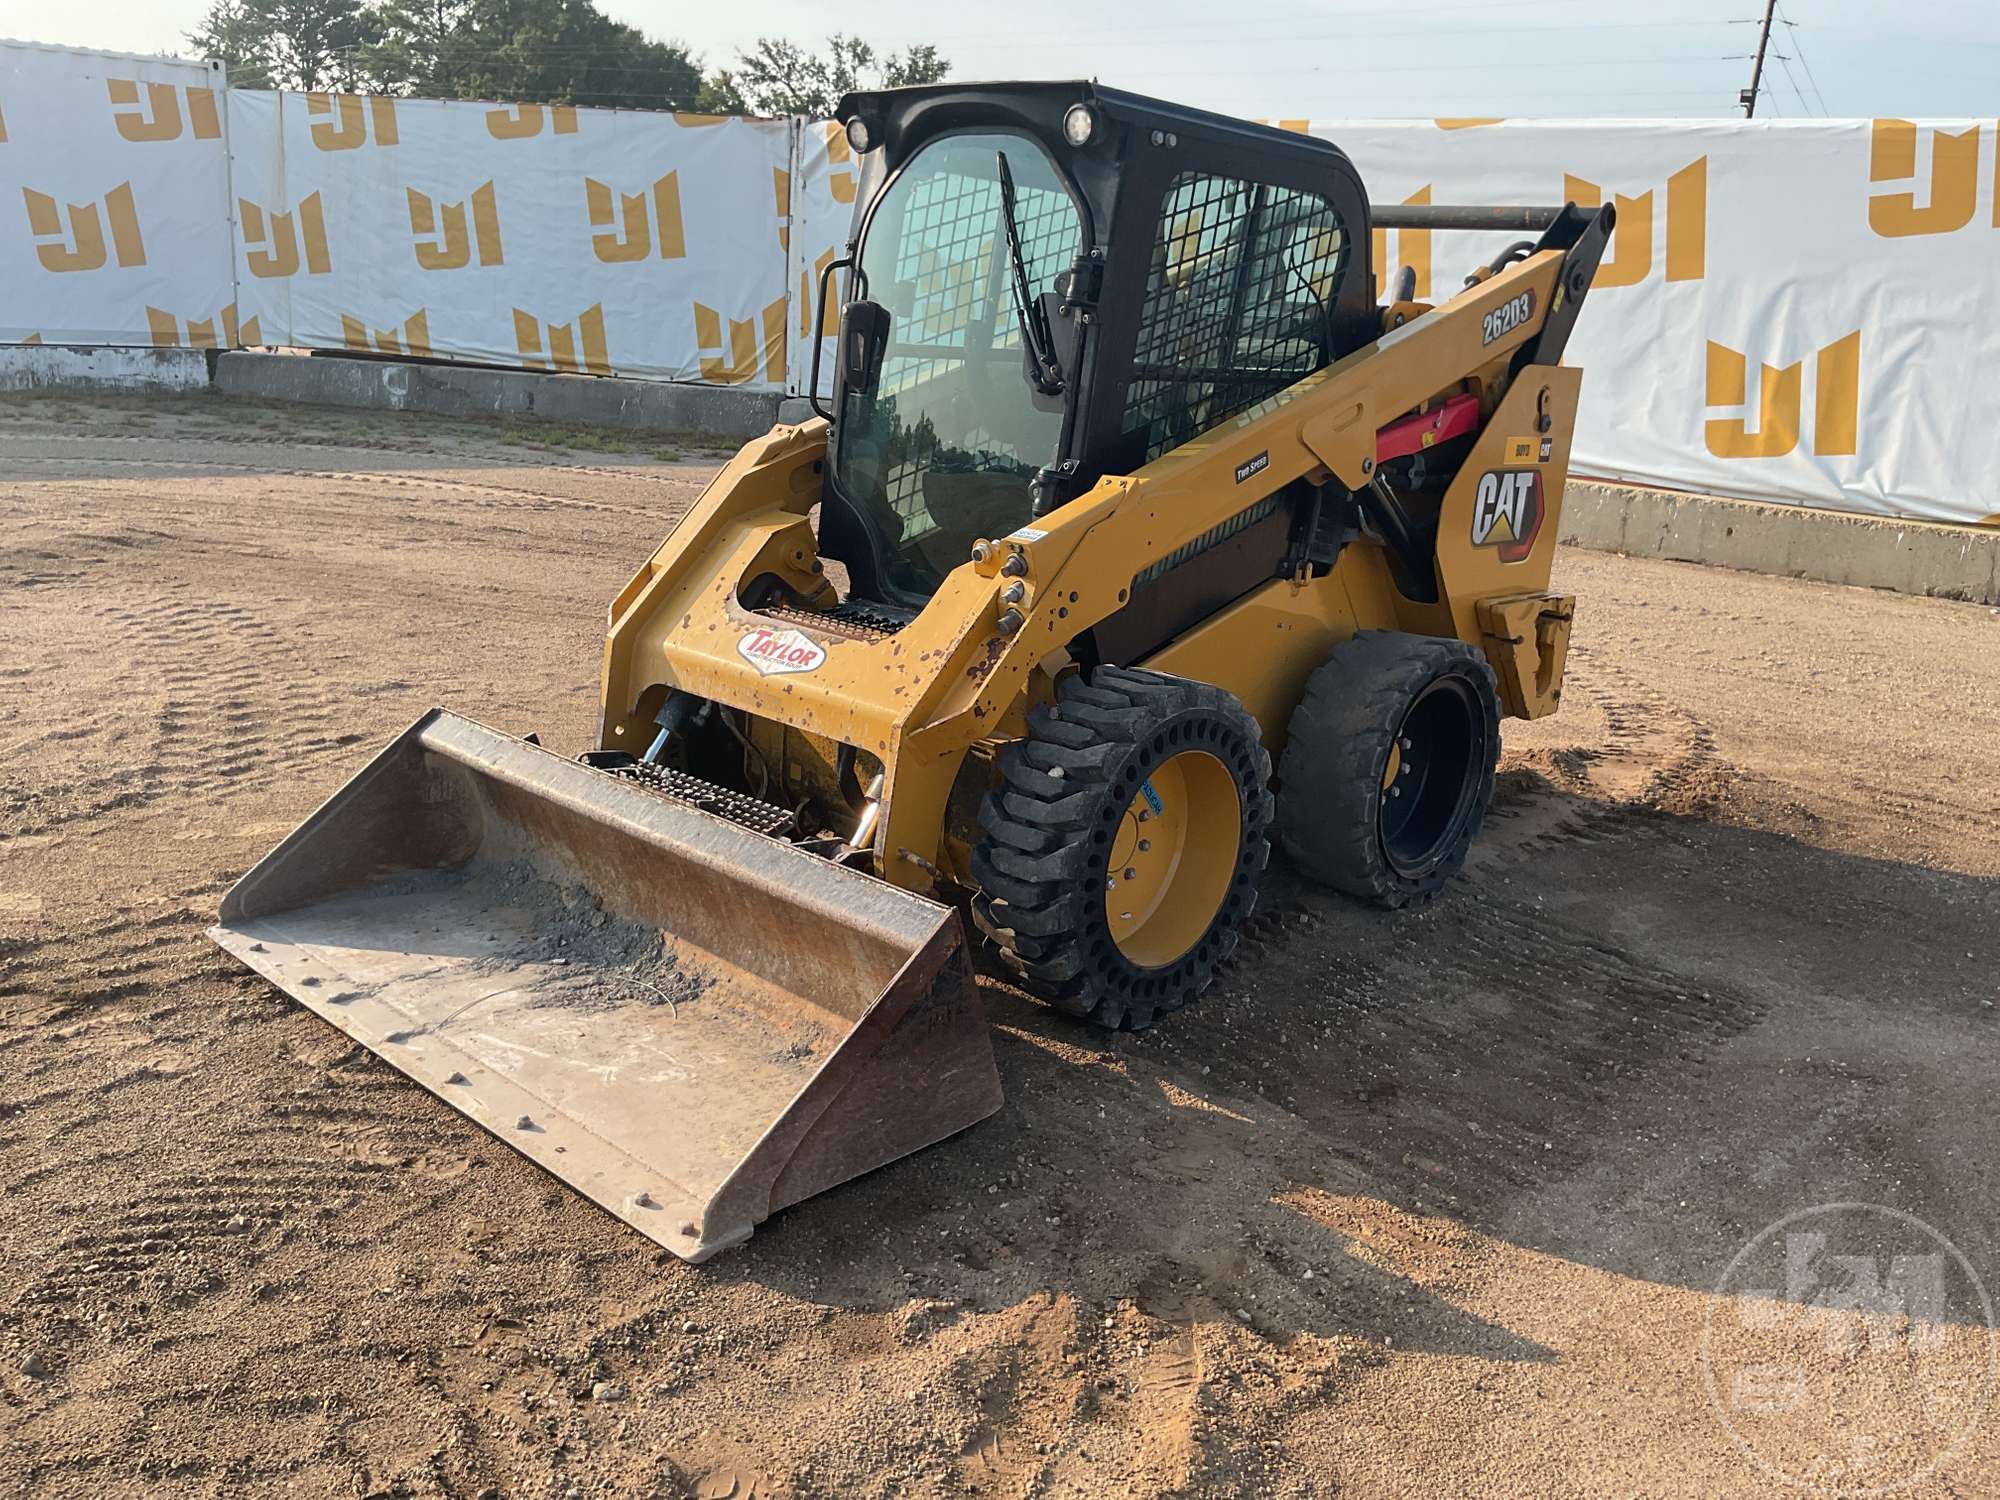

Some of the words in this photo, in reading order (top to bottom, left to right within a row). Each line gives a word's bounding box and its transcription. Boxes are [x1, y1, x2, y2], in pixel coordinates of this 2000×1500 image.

[1483, 293, 1529, 345] 262D3
[1540, 443, 1552, 457] CAT
[1472, 472, 1534, 545] CAT
[746, 629, 818, 666] TAYLOR
